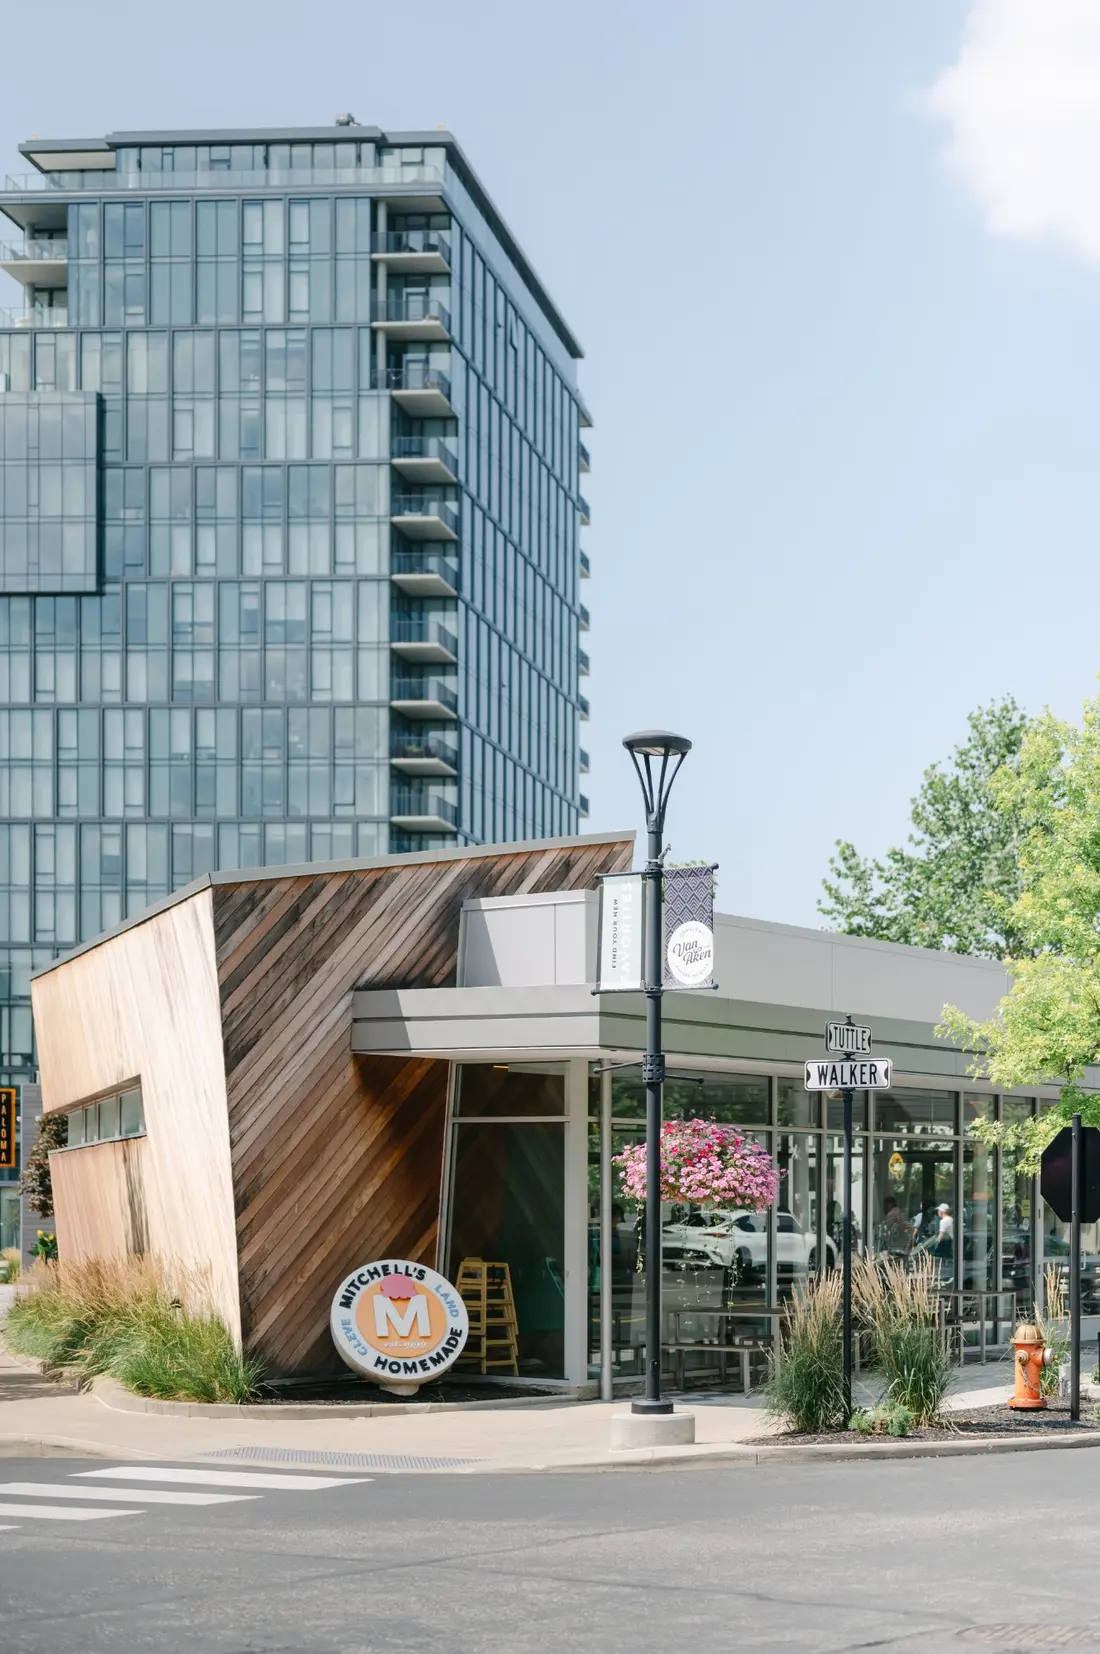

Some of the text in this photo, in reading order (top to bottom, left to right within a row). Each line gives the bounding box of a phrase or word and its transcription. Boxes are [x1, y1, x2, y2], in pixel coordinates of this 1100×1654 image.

[672, 939, 699, 958] Van
[682, 946, 712, 966] Aken
[833, 1026, 867, 1051] TUTTLE
[817, 1063, 878, 1086] WALKER
[339, 1264, 427, 1310] MITCHELL'S
[434, 1284, 460, 1319] LAND
[373, 1294, 432, 1338] M
[340, 1318, 368, 1357] CLEVE
[373, 1327, 463, 1375] HOMEMADE
